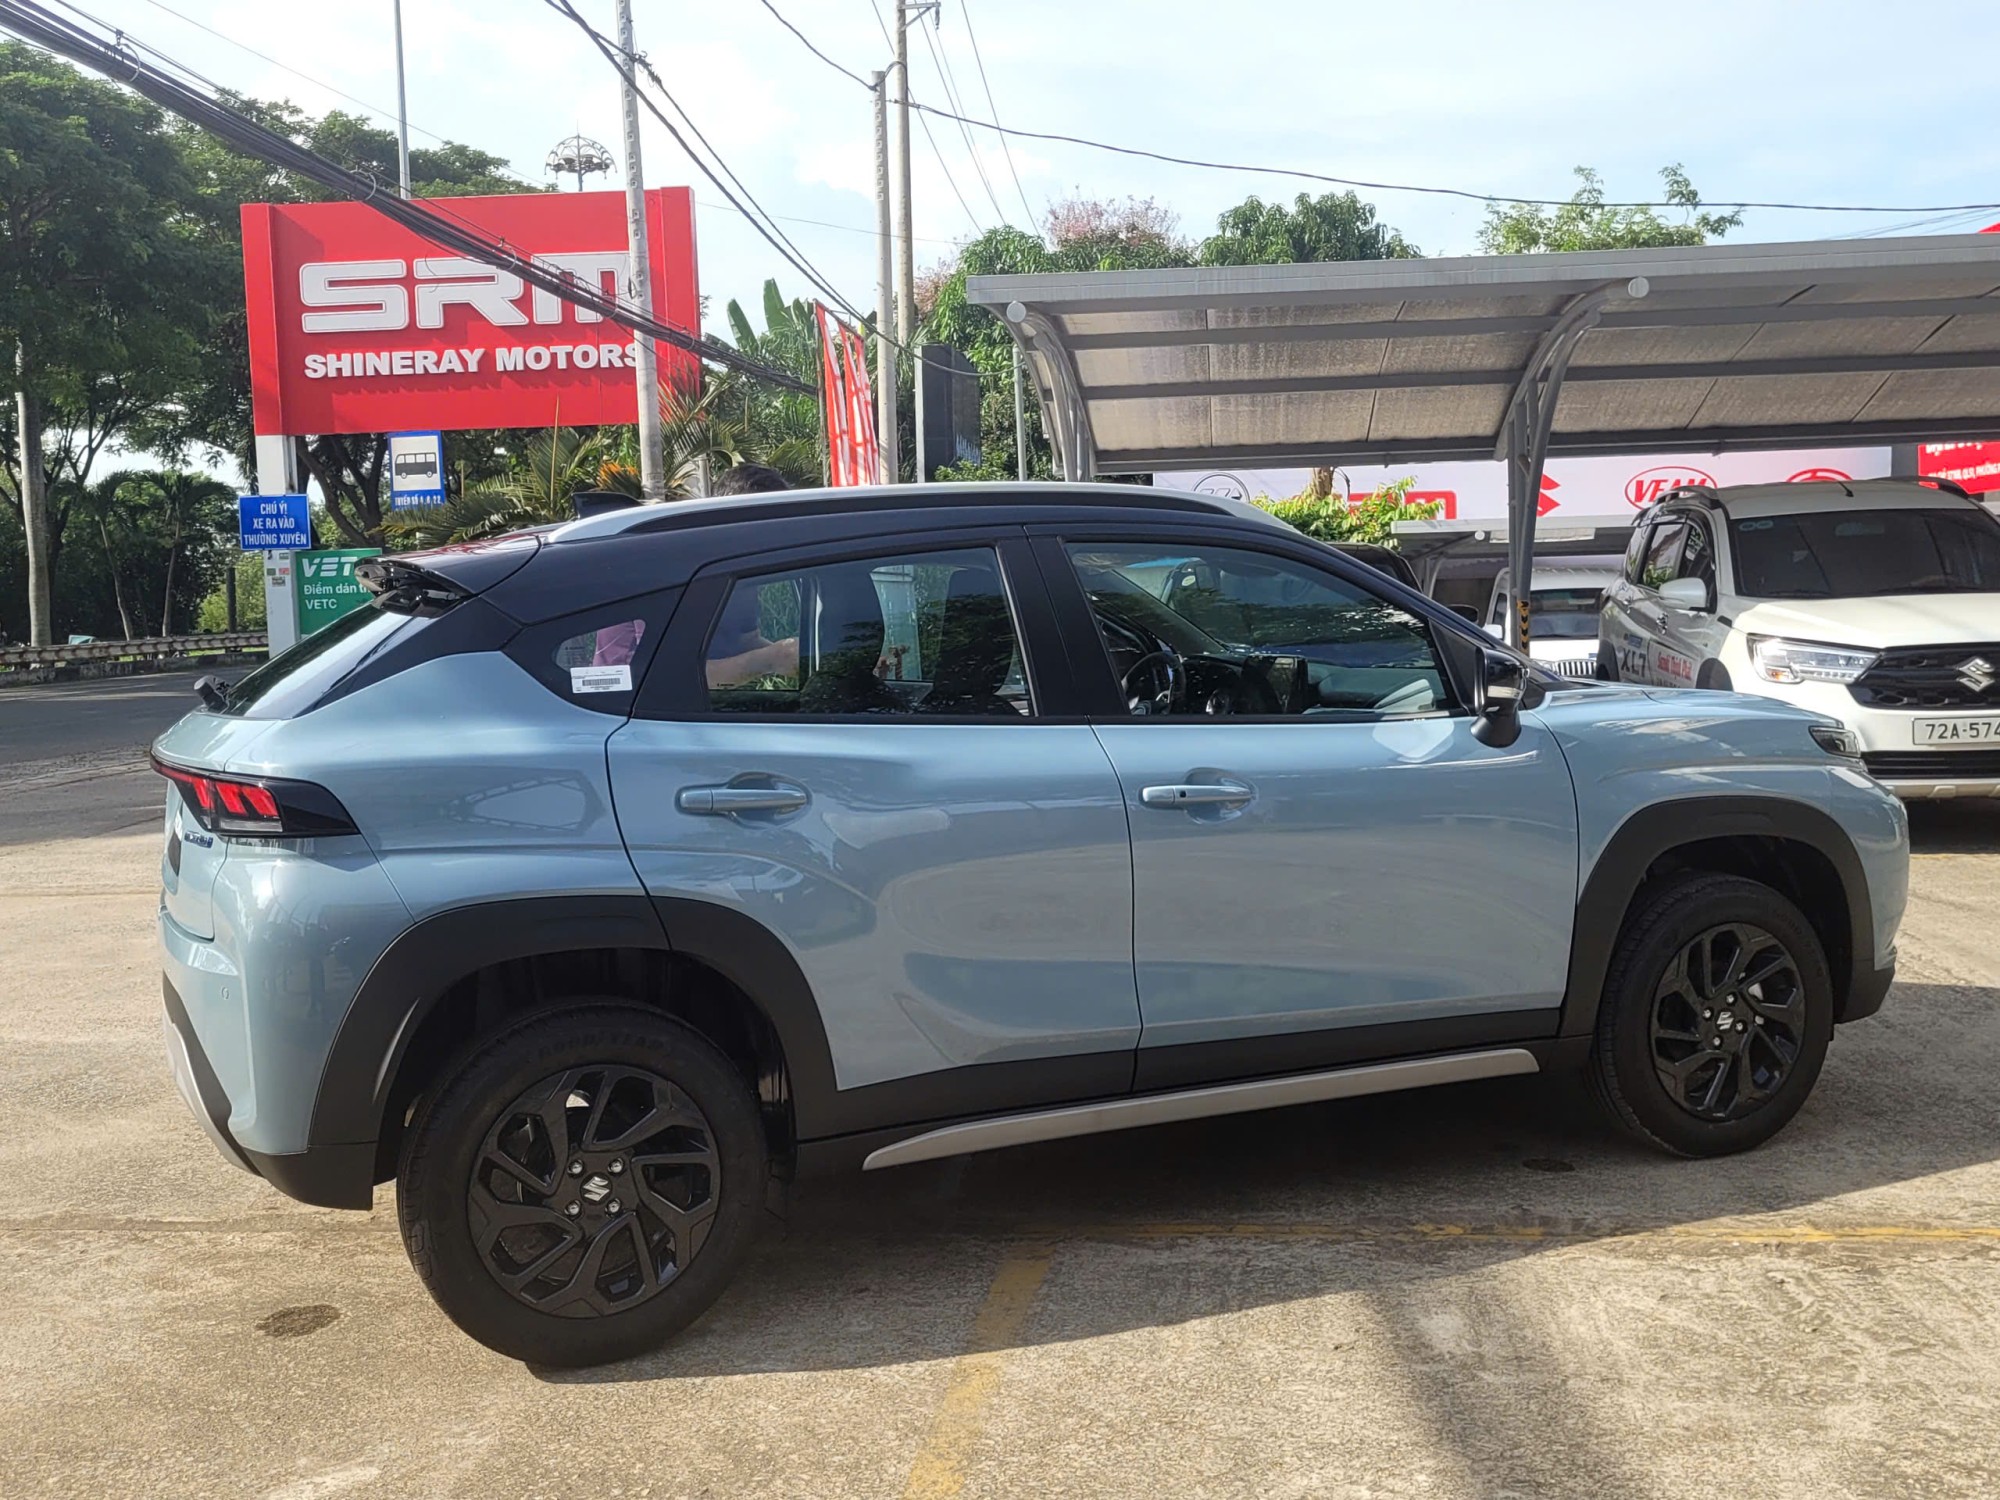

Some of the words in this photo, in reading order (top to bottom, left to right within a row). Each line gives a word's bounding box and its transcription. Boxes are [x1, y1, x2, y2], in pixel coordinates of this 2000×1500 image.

[299, 251, 632, 333] SRM
[304, 348, 485, 378] SHINERAY
[496, 342, 639, 372] MOTORS
[260, 501, 277, 515] CHÚ
[279, 500, 288, 515] Ý!
[253, 518, 264, 529] XE
[266, 518, 278, 529] RA
[278, 515, 295, 529] VÀO
[244, 532, 278, 545] THƯỜNG
[280, 532, 307, 545] XUYÊN
[304, 582, 333, 595] Điểm
[336, 583, 357, 594] dán
[305, 599, 337, 610] VETC
[1621, 647, 1647, 678] XL7
[1925, 722, 2000, 740] 72A-574
